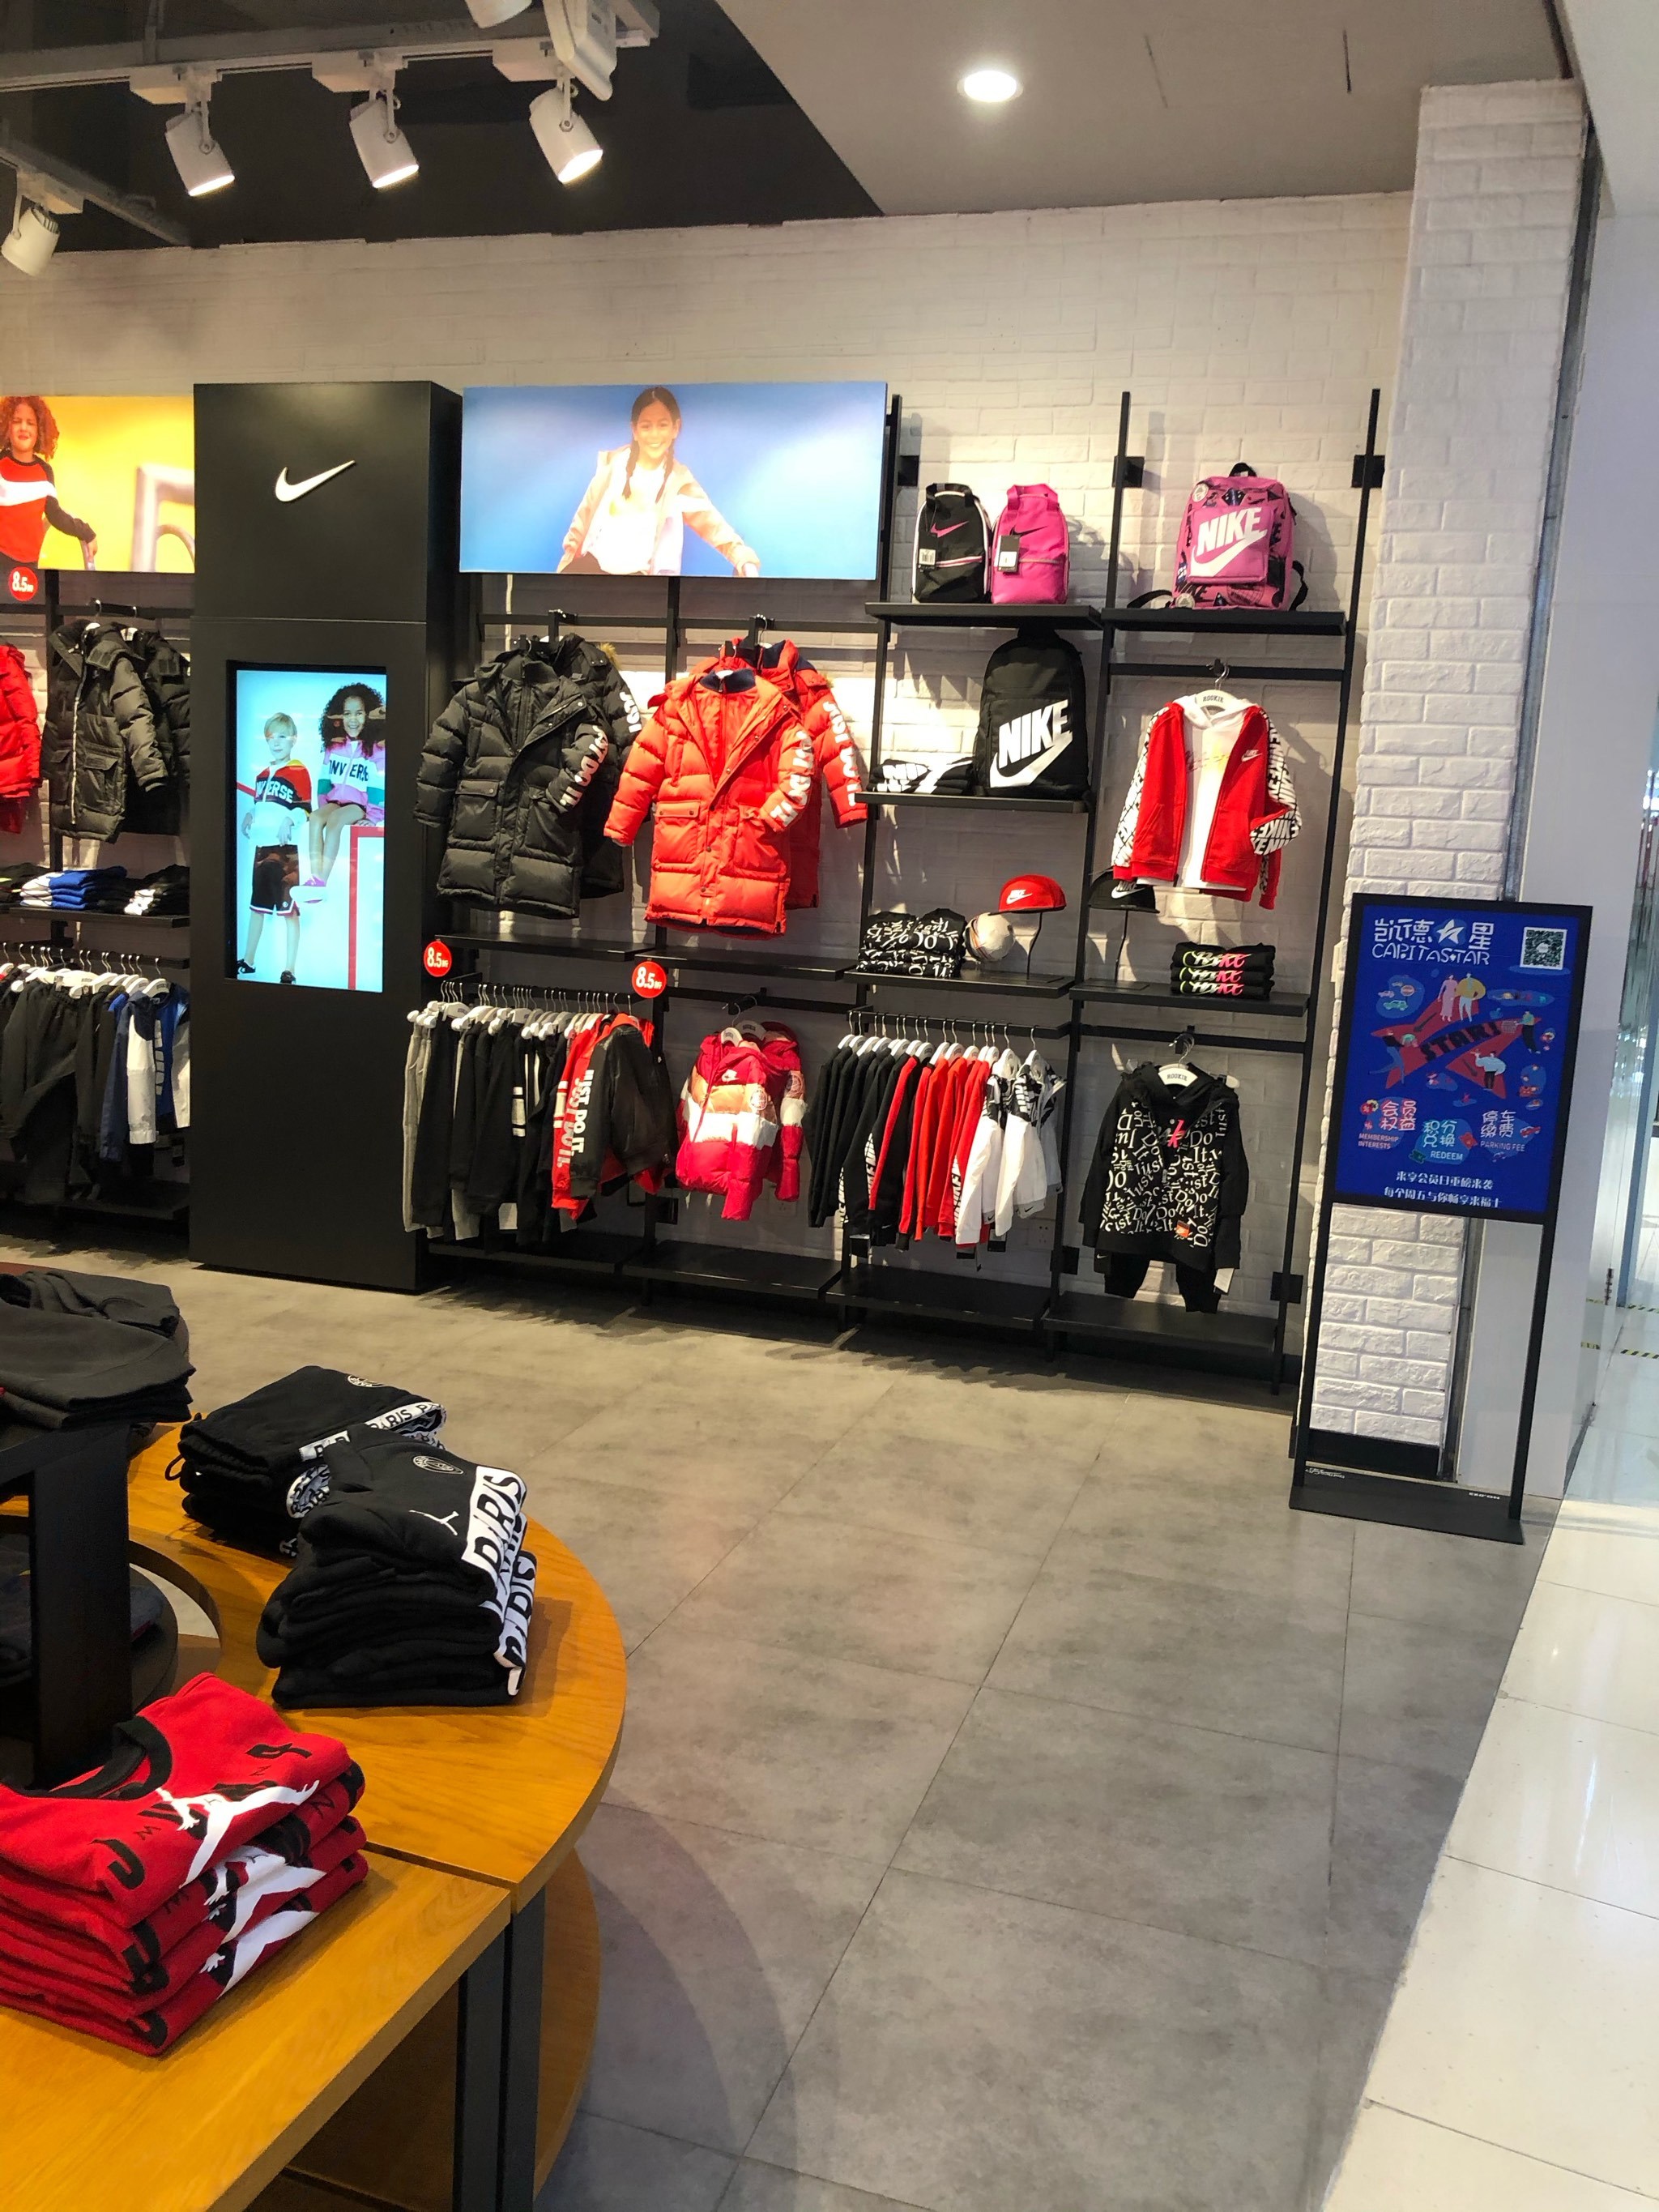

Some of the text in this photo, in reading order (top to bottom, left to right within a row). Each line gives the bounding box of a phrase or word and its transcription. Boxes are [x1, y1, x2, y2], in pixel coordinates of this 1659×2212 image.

[1196, 507, 1262, 557] NIKE
[999, 699, 1069, 769] NIKE
[1371, 942, 1491, 965] CAPITASTAR
[635, 967, 662, 989] 8.5折
[1166, 1073, 1188, 1082] ROOKIE
[1382, 1100, 1417, 1117] 会员
[574, 1109, 588, 1134] DO
[1380, 1117, 1416, 1131] 权益
[1482, 1110, 1516, 1124] 停车
[1423, 1120, 1457, 1134] 积分
[1480, 1123, 1514, 1138] 缴费
[1358, 1133, 1399, 1142] MEMBERSHIP
[1358, 1140, 1391, 1149] INTERESTS
[1422, 1133, 1456, 1147] 兑换
[1480, 1140, 1526, 1151] PARKING FEE
[1430, 1151, 1463, 1161] REDEEM
